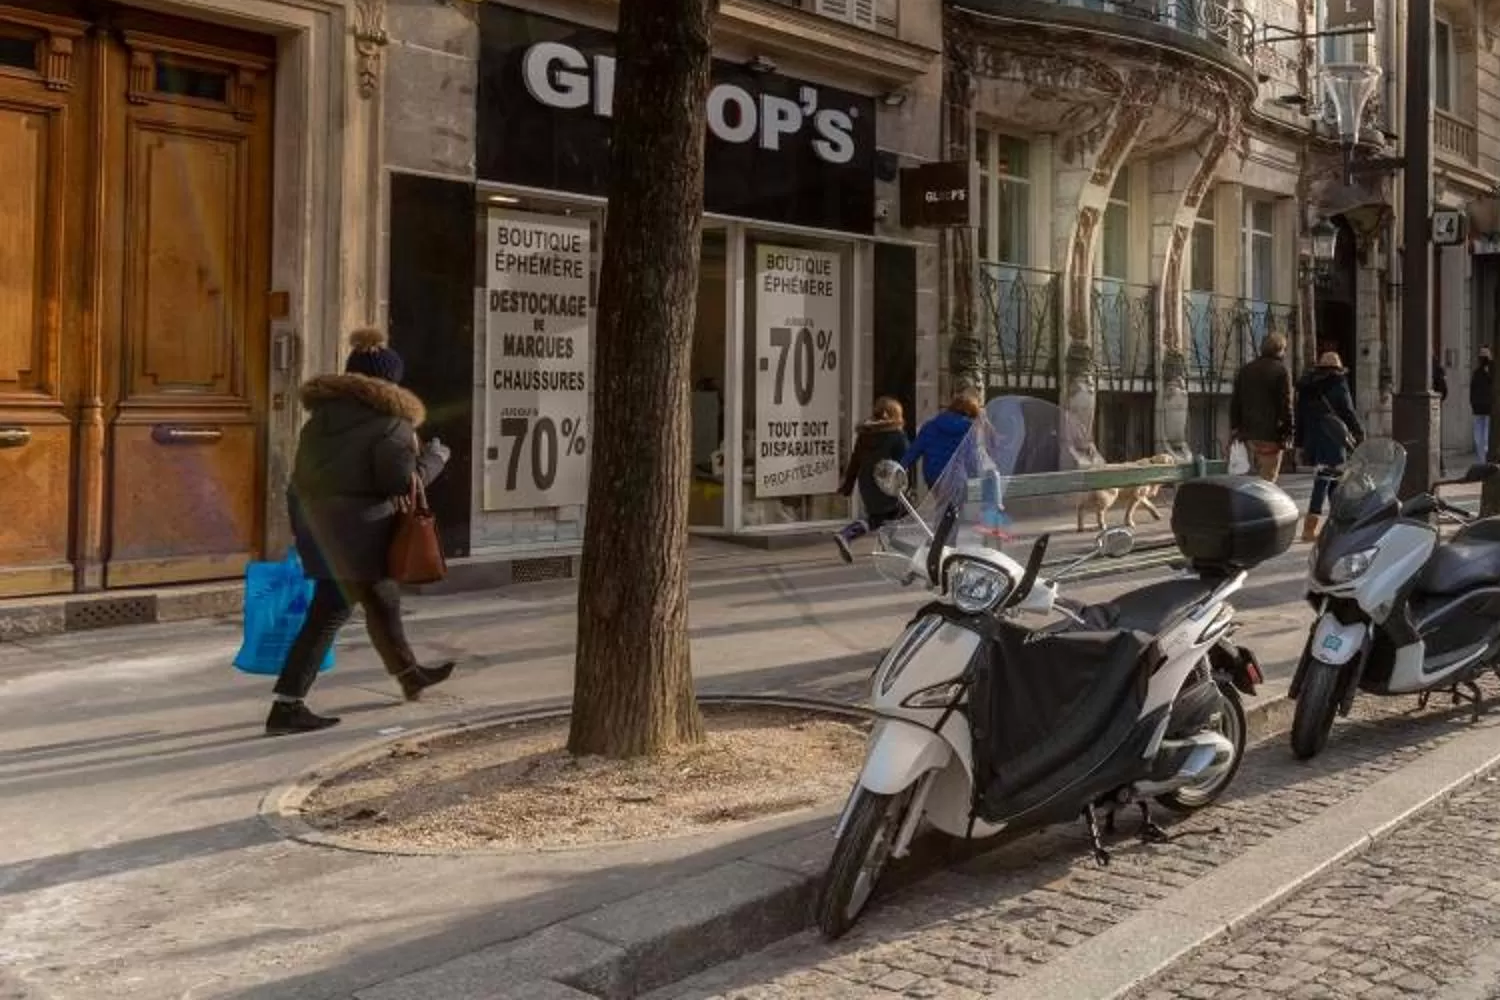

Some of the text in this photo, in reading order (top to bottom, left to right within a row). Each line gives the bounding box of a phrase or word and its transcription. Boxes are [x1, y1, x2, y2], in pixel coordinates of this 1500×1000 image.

[522, 41, 855, 164] GLOP'S
[497, 227, 581, 254] BOUTIQUE
[495, 249, 584, 279] ÉPHÉMÈRE
[766, 253, 832, 276] BOUTIQUE
[489, 289, 587, 318] DESTOCKAGE
[503, 333, 575, 360] MARQUES
[493, 369, 585, 391] CHAUSSURES
[768, 421, 799, 438] TOUT
[801, 421, 829, 437] DOIT
